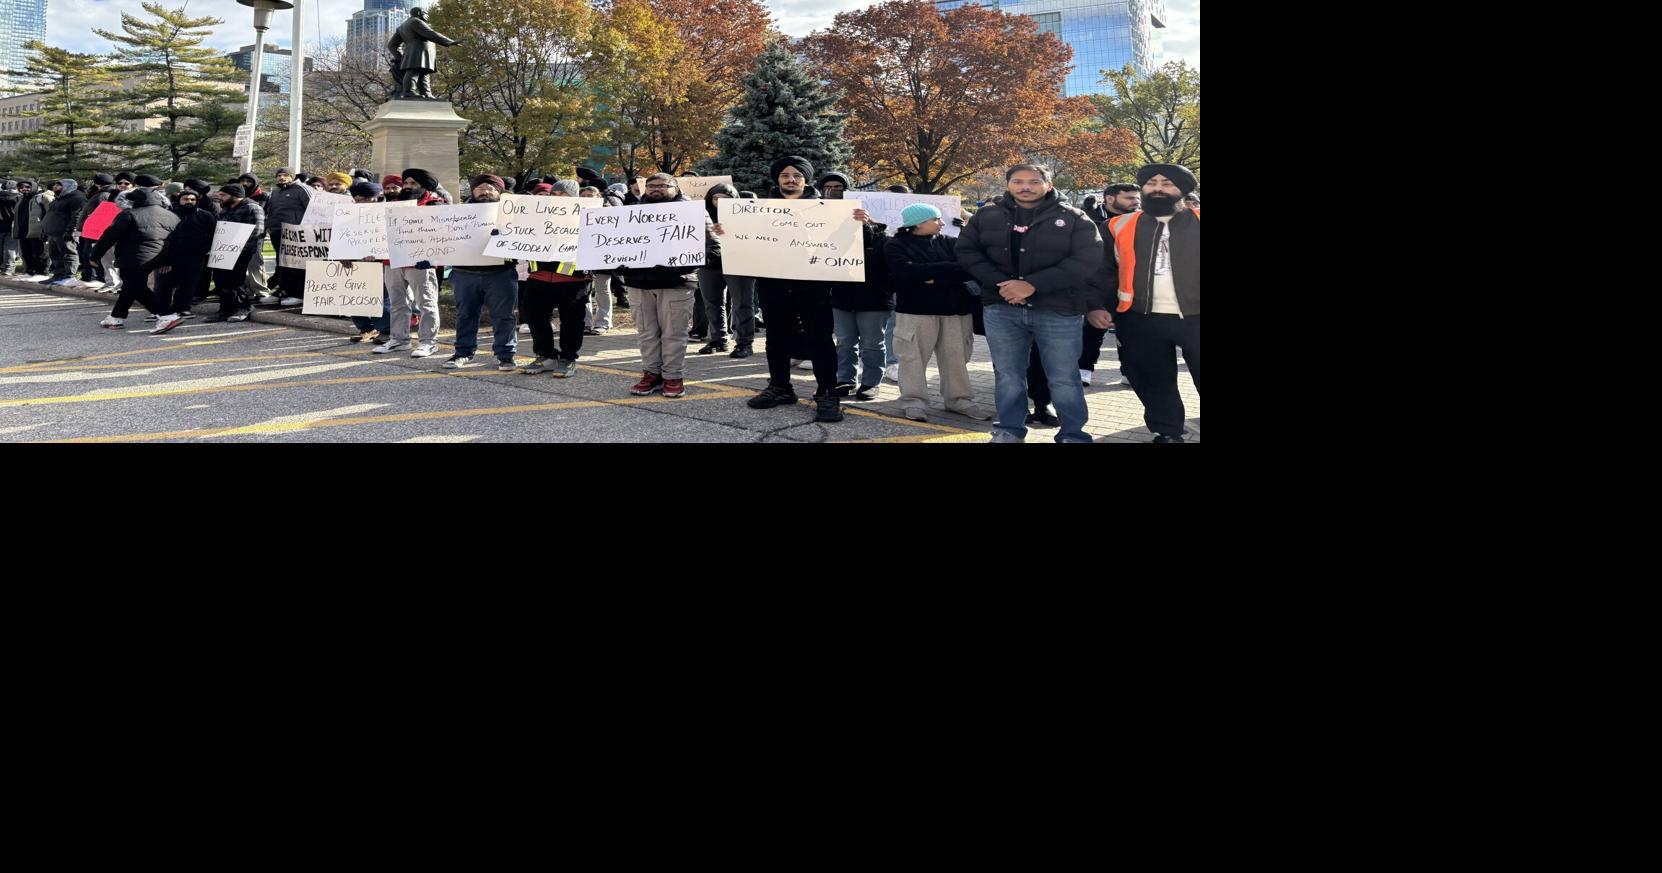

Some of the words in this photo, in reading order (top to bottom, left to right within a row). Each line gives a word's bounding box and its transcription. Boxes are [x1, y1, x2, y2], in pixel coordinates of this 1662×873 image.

[503, 199, 528, 215] OUR
[535, 201, 567, 216] LIVES
[571, 203, 585, 215] A
[732, 202, 794, 217] DIRECTOR
[585, 211, 620, 229] EVERY
[628, 209, 678, 224] WORKER
[771, 220, 799, 228] COME
[501, 222, 536, 236] STUCK
[591, 233, 651, 248] DESERVES
[656, 224, 700, 243] FAIR
[496, 240, 509, 248] OF
[508, 241, 552, 253] SUDDEN
[734, 233, 749, 241] WE
[789, 239, 837, 250] ANSWERS
[306, 280, 337, 292] PLEASE
[344, 279, 368, 290] GIVE
[313, 296, 336, 307] FAIR
[339, 295, 384, 306] DECISION
